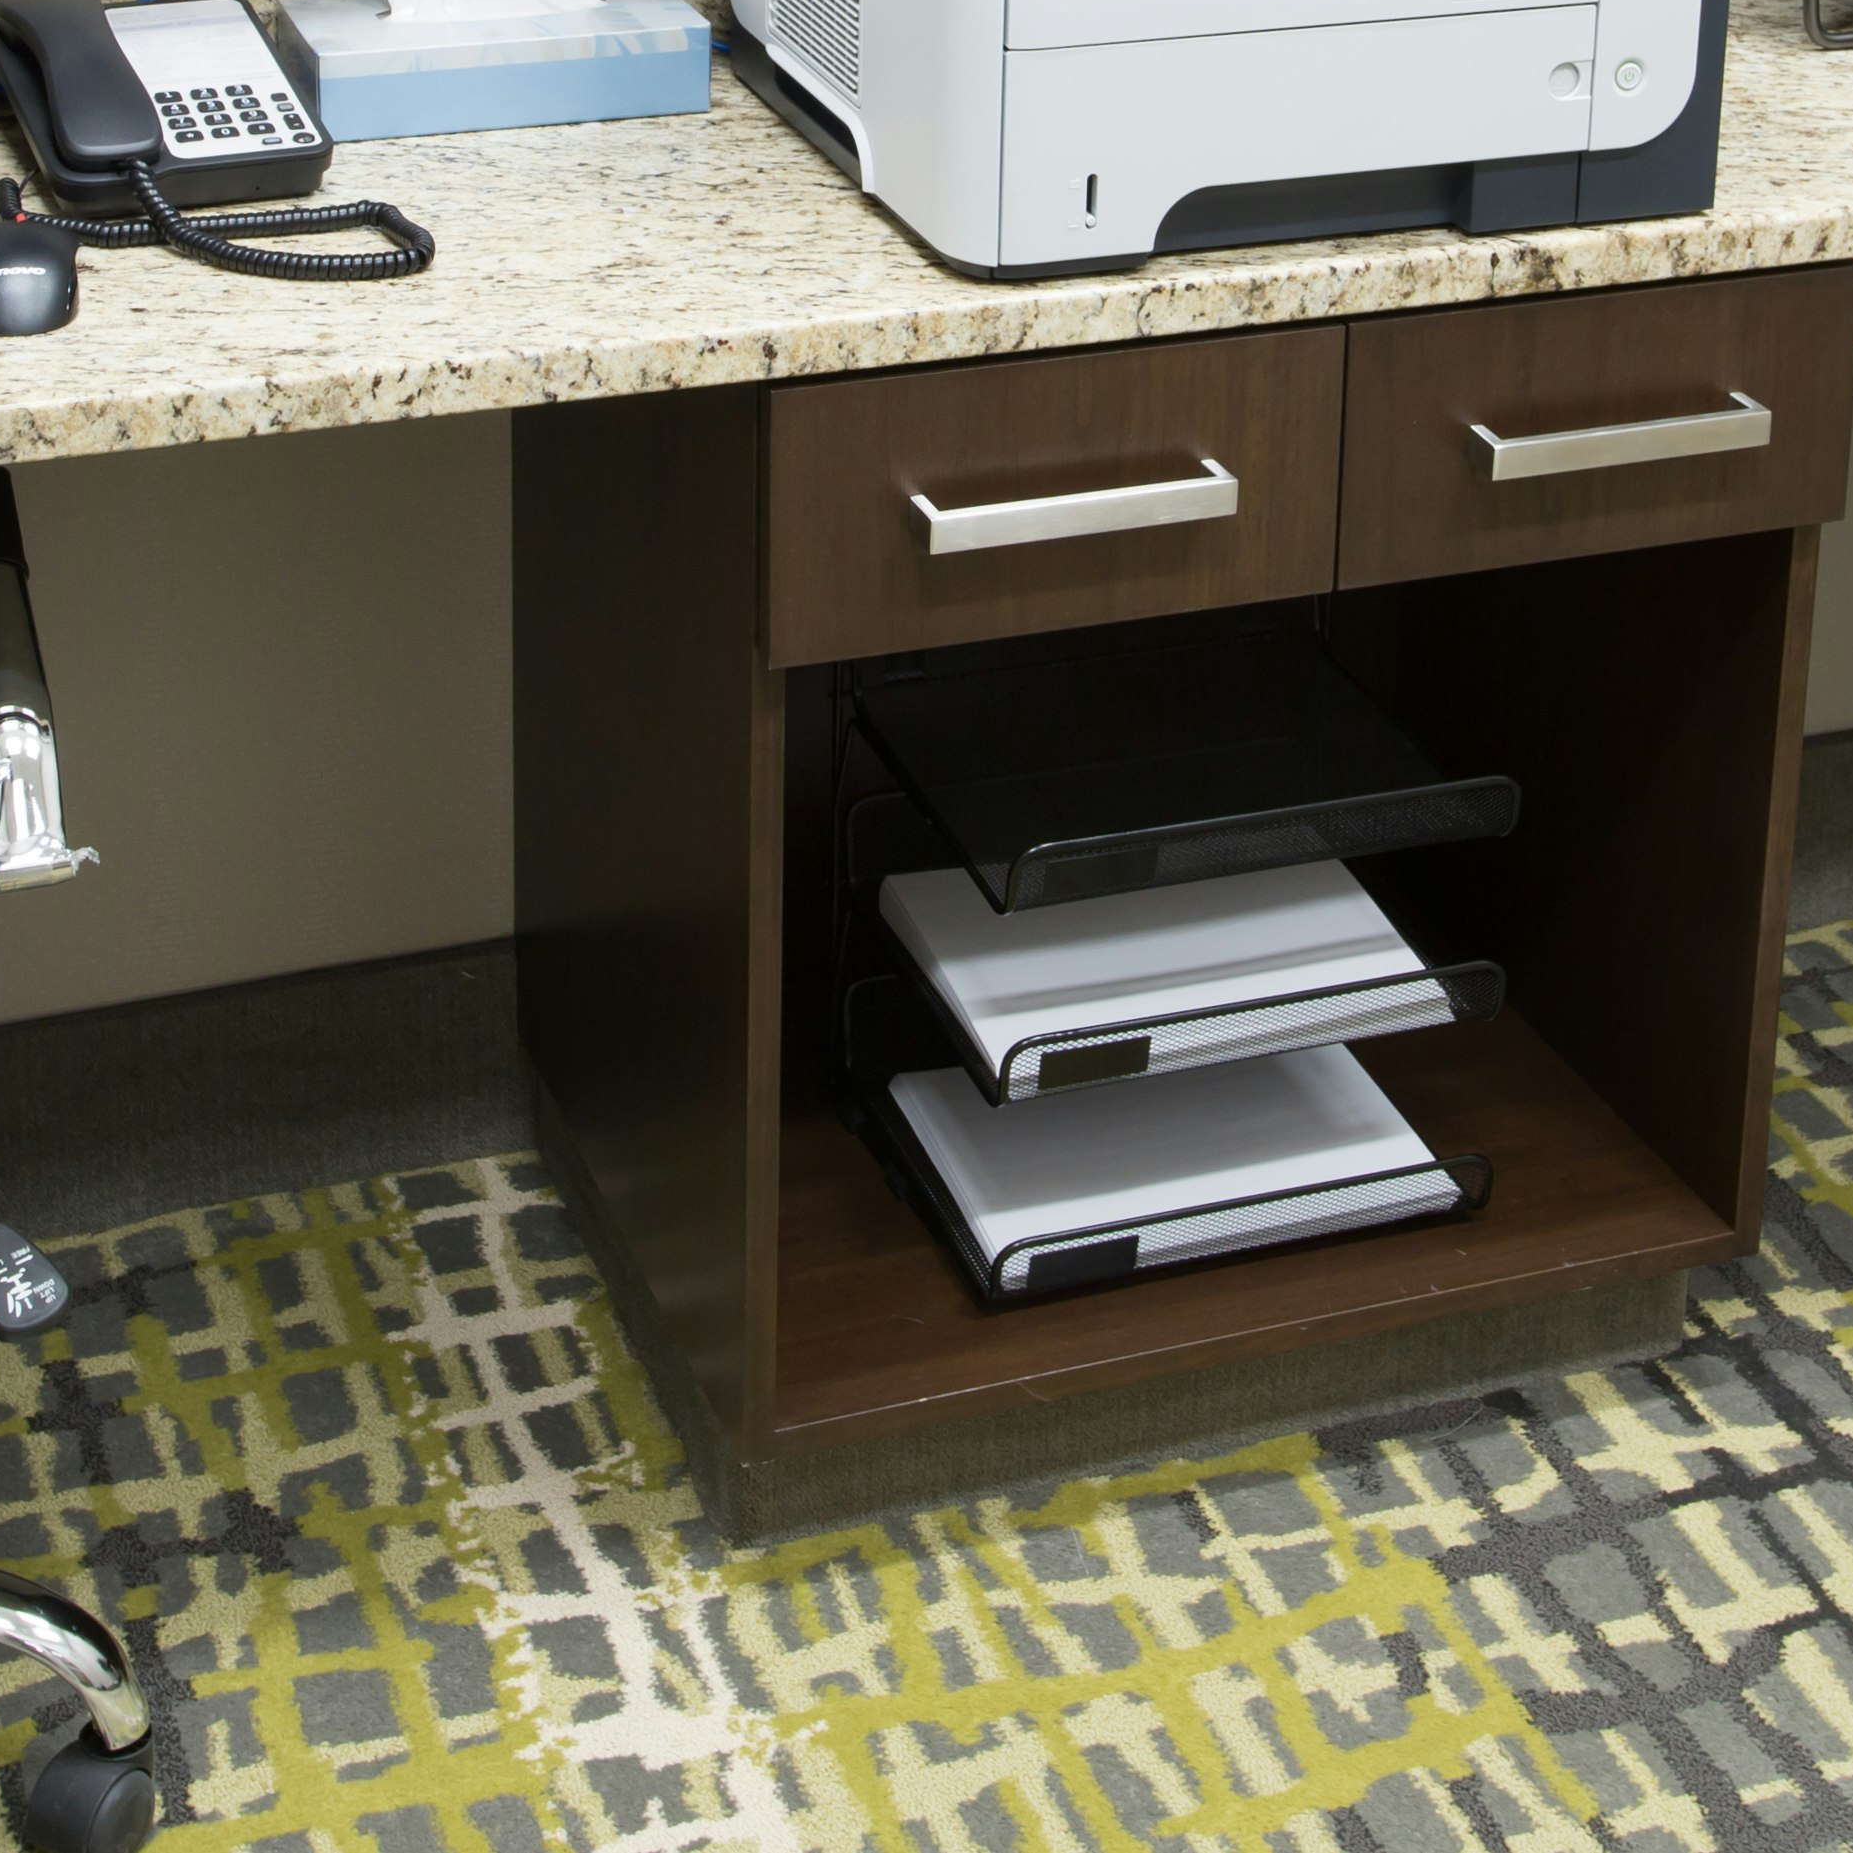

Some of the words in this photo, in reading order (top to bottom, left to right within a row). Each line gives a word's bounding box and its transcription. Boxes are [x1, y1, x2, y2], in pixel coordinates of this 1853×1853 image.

[10, 1245, 31, 1260] FREE
[32, 1278, 56, 1294] DOWN
[39, 1286, 56, 1299] LIFT
